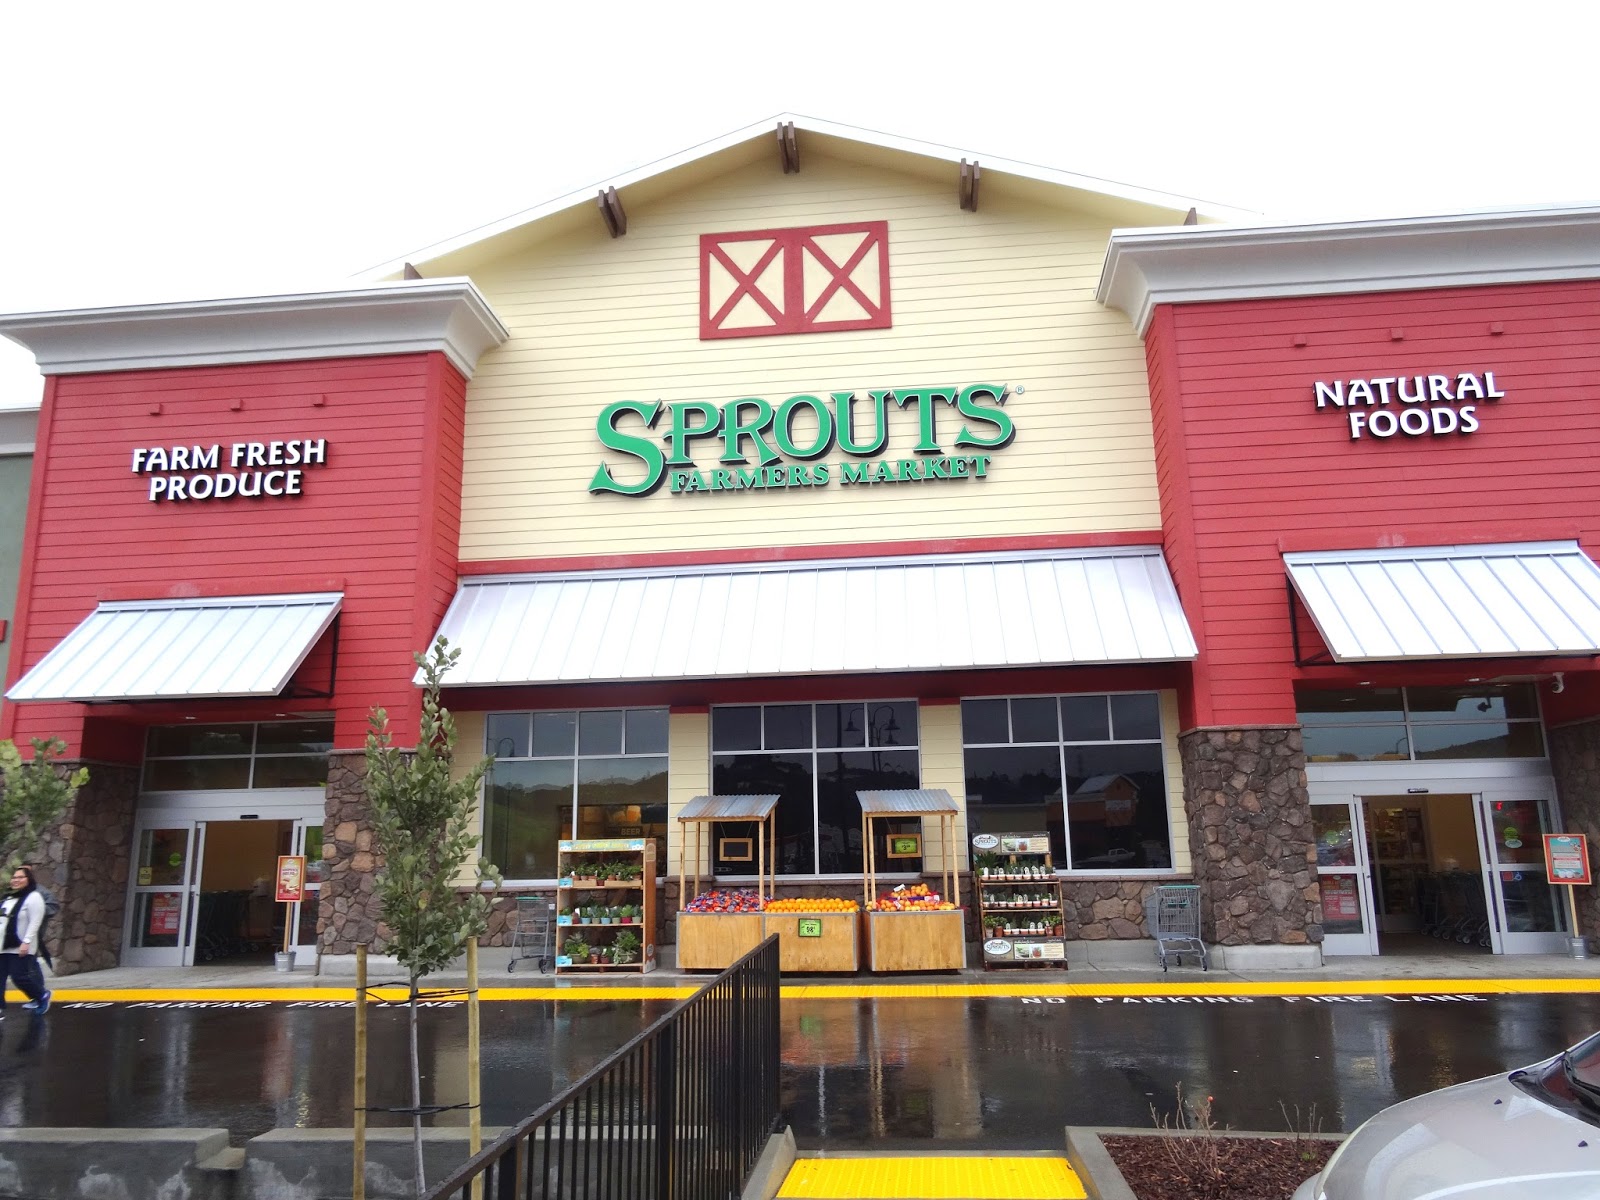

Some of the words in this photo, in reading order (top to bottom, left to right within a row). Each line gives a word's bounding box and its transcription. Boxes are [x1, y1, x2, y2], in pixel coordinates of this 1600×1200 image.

[1313, 372, 1505, 408] NATURAL
[1347, 406, 1479, 439] FOODS
[131, 444, 221, 473] FARM
[230, 438, 328, 468] FRESH
[588, 383, 1016, 496] SPROUTS
[148, 470, 303, 501] PRODUCE
[669, 463, 830, 494] FARMERS
[839, 454, 992, 486] MARKET
[621, 828, 641, 836] BEER
[125, 1001, 272, 1009] PARKING
[1021, 996, 1066, 1004] NO
[1093, 996, 1254, 1004] PARKING
[1383, 994, 1487, 1002] LANE
